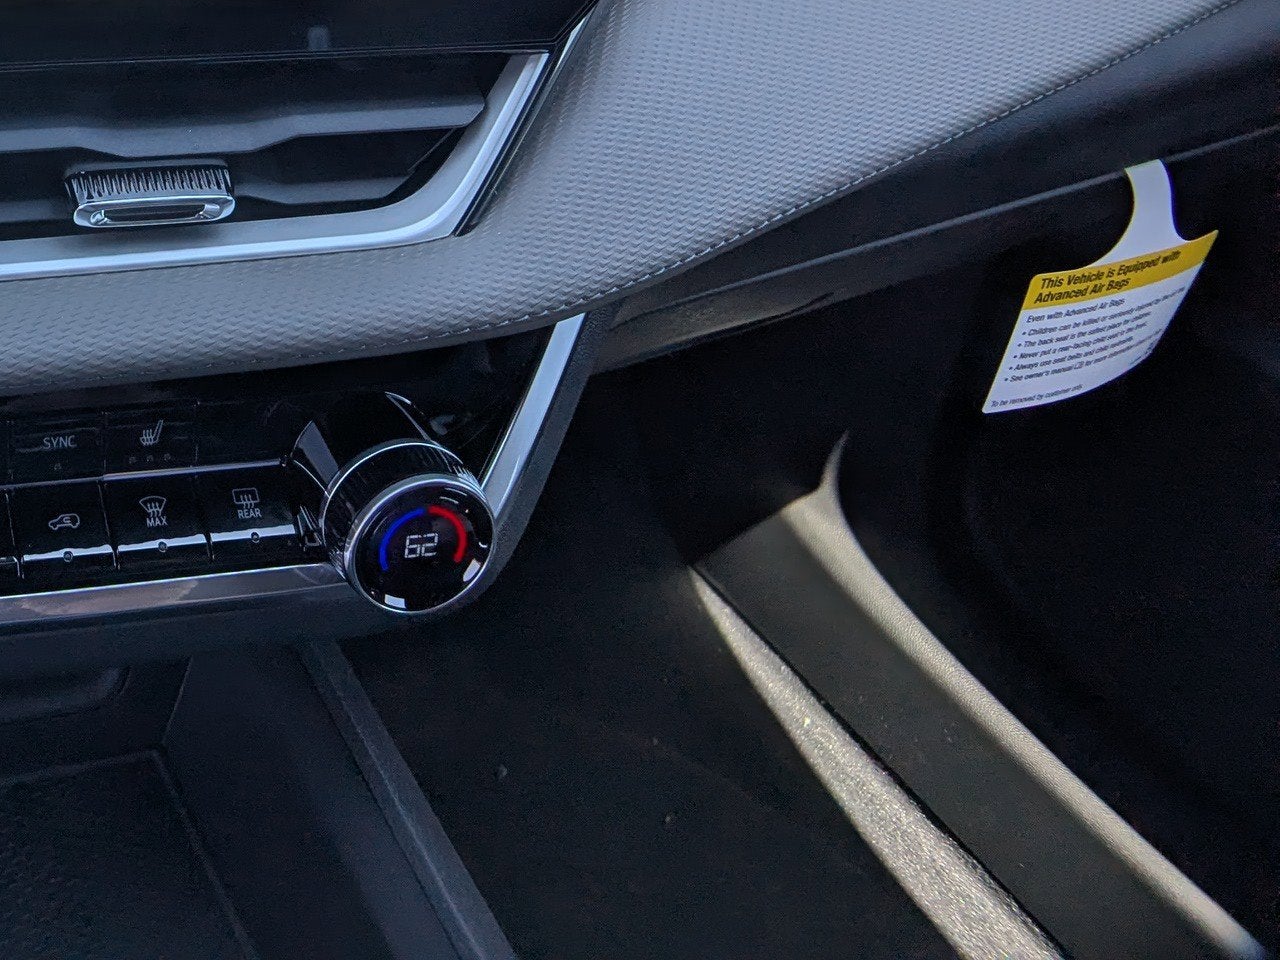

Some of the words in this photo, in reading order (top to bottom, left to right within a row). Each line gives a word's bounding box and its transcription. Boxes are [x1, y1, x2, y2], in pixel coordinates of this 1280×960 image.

[1041, 277, 1064, 289] This
[1067, 270, 1105, 286] Vehicle
[1106, 268, 1116, 279] is
[1117, 255, 1161, 276] Equipped
[1034, 286, 1089, 304] Advanced
[1090, 282, 1106, 294] Air
[1106, 278, 1131, 291] Bags
[1026, 315, 1045, 324] Even
[1019, 352, 1040, 360] Never
[1014, 362, 1040, 371] Always
[43, 435, 77, 450] SYNC
[237, 507, 263, 519] REAR
[146, 516, 168, 528] MAX
[404, 533, 439, 559] 62
